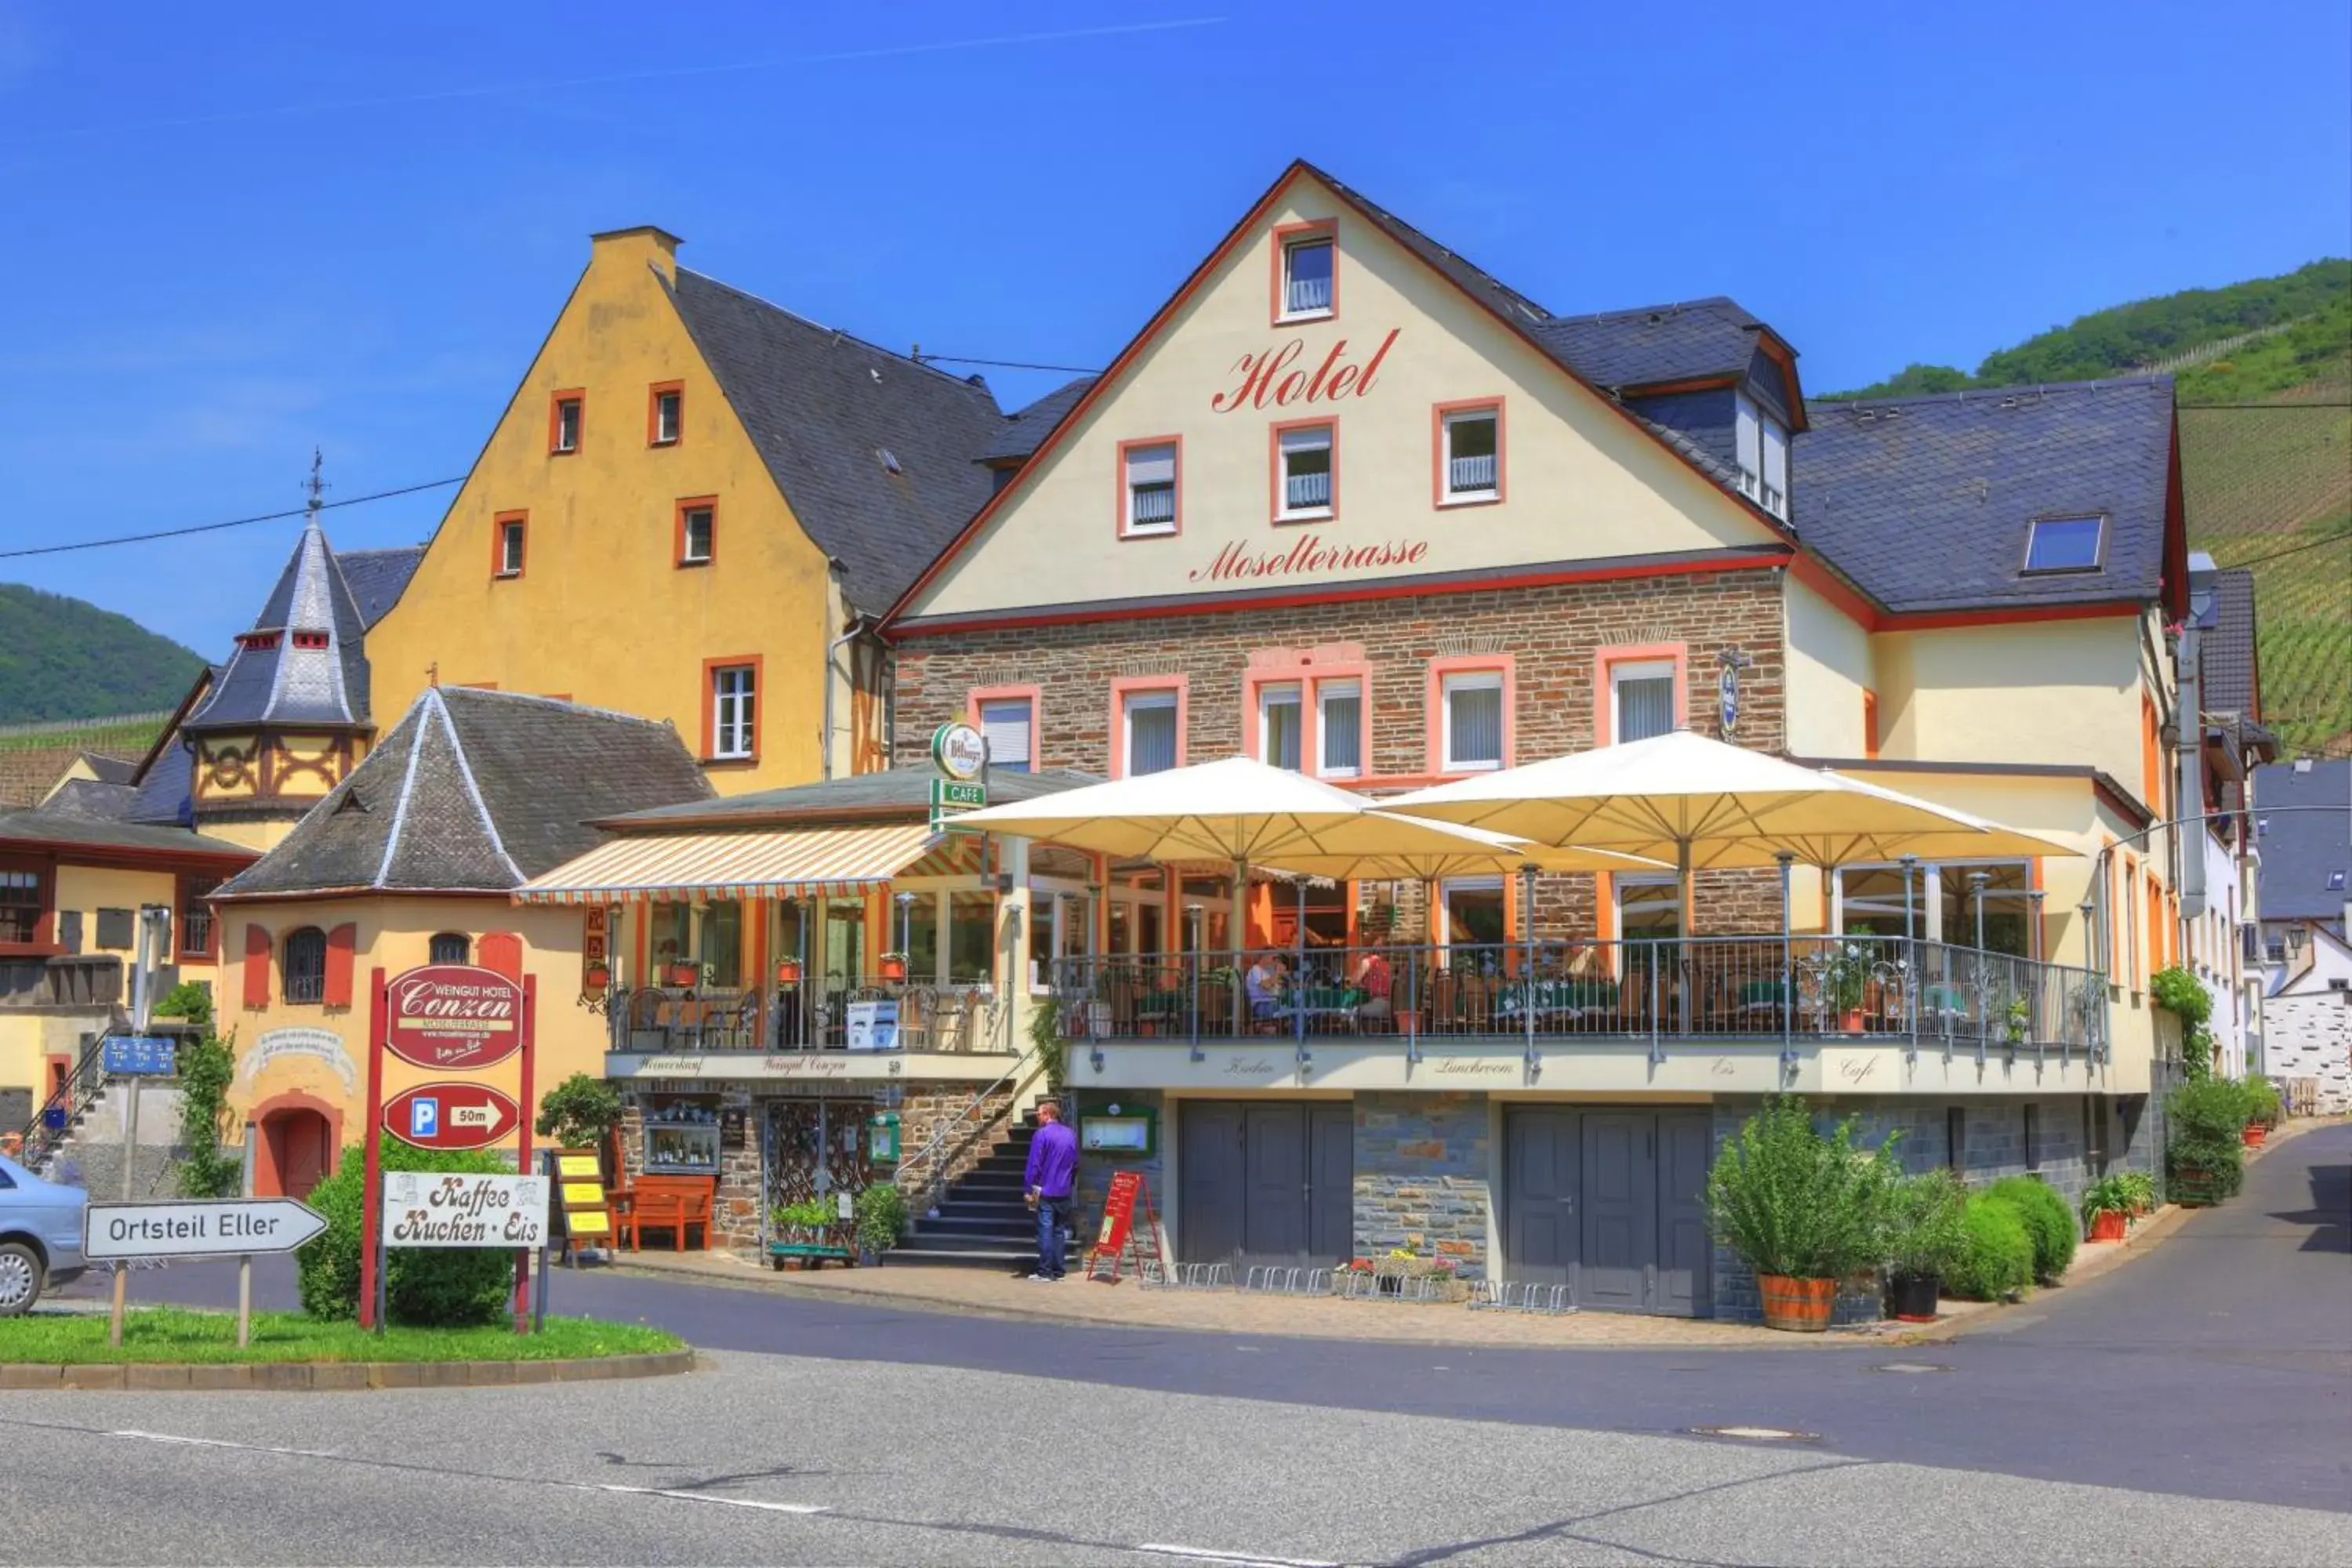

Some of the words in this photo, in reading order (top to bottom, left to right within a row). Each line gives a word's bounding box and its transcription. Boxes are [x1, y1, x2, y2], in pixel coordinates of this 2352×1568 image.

[1211, 328, 1402, 414] Hotel
[1189, 533, 1428, 583] Moselterrasse
[401, 979, 514, 1018] Conzen
[435, 985, 480, 996] WEINGUT
[482, 987, 512, 998] HOTEL
[413, 1103, 434, 1131] P
[459, 1110, 486, 1122] 50m
[430, 1177, 510, 1217] Kaffee
[109, 1215, 205, 1240] Ortsteil
[219, 1214, 280, 1237] Eller
[394, 1210, 486, 1241] Kuchen
[503, 1211, 539, 1241] Eis
